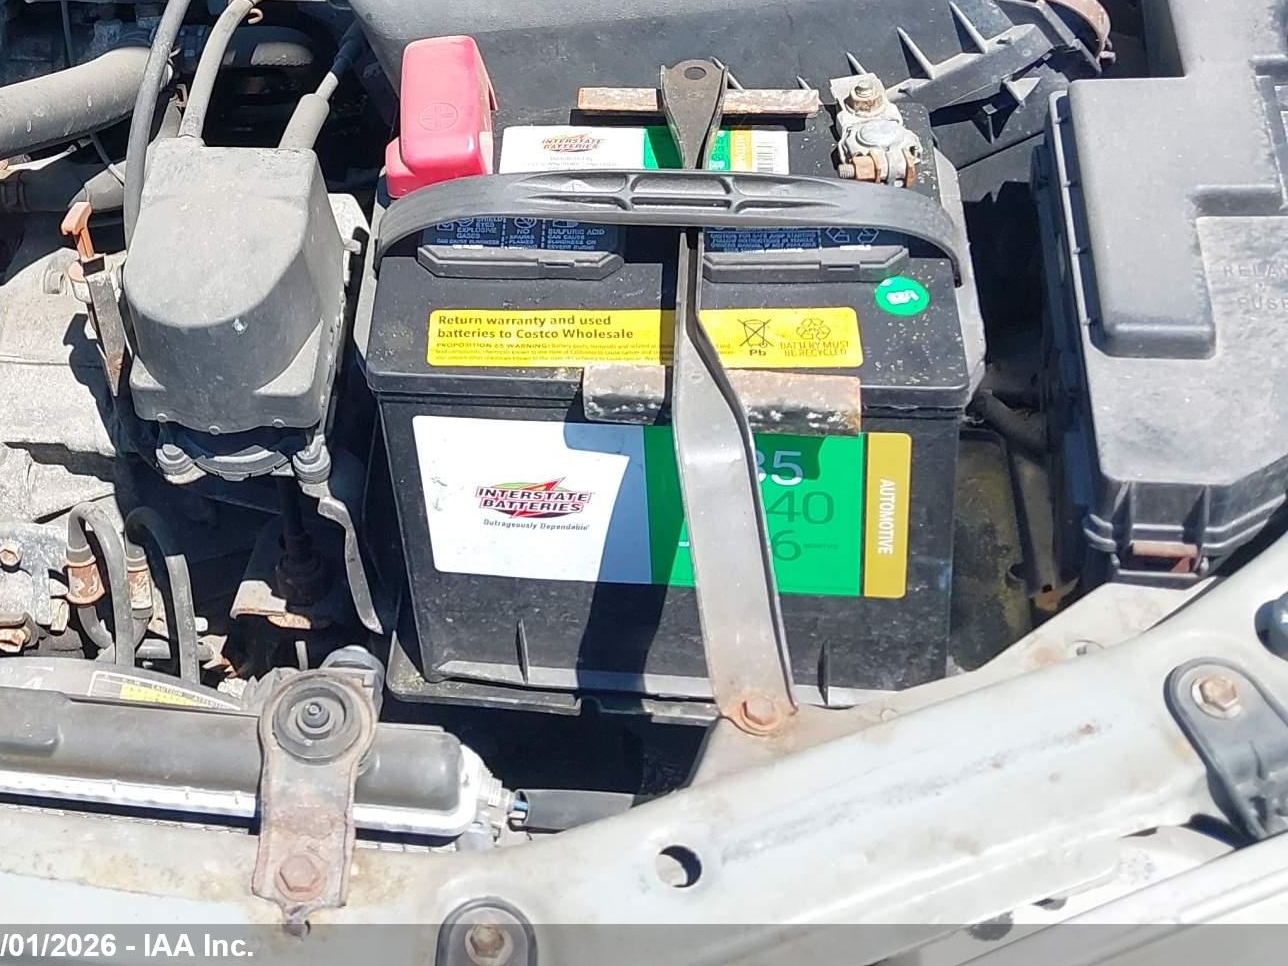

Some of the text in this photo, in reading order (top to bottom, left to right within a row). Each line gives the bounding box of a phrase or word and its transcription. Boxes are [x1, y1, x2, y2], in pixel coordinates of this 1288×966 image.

[438, 314, 611, 327] Return warranty and used
[437, 328, 633, 339] batteries to Costco Wholesale
[780, 340, 849, 350] BATTERY MUST
[749, 348, 767, 357] Pb
[784, 348, 847, 357] BE RECYCLED
[478, 488, 589, 502] INTERSTATE
[482, 499, 582, 512] BATTERIES
[877, 479, 896, 555] AUTOMOTIVE
[483, 518, 538, 530] Outrageously
